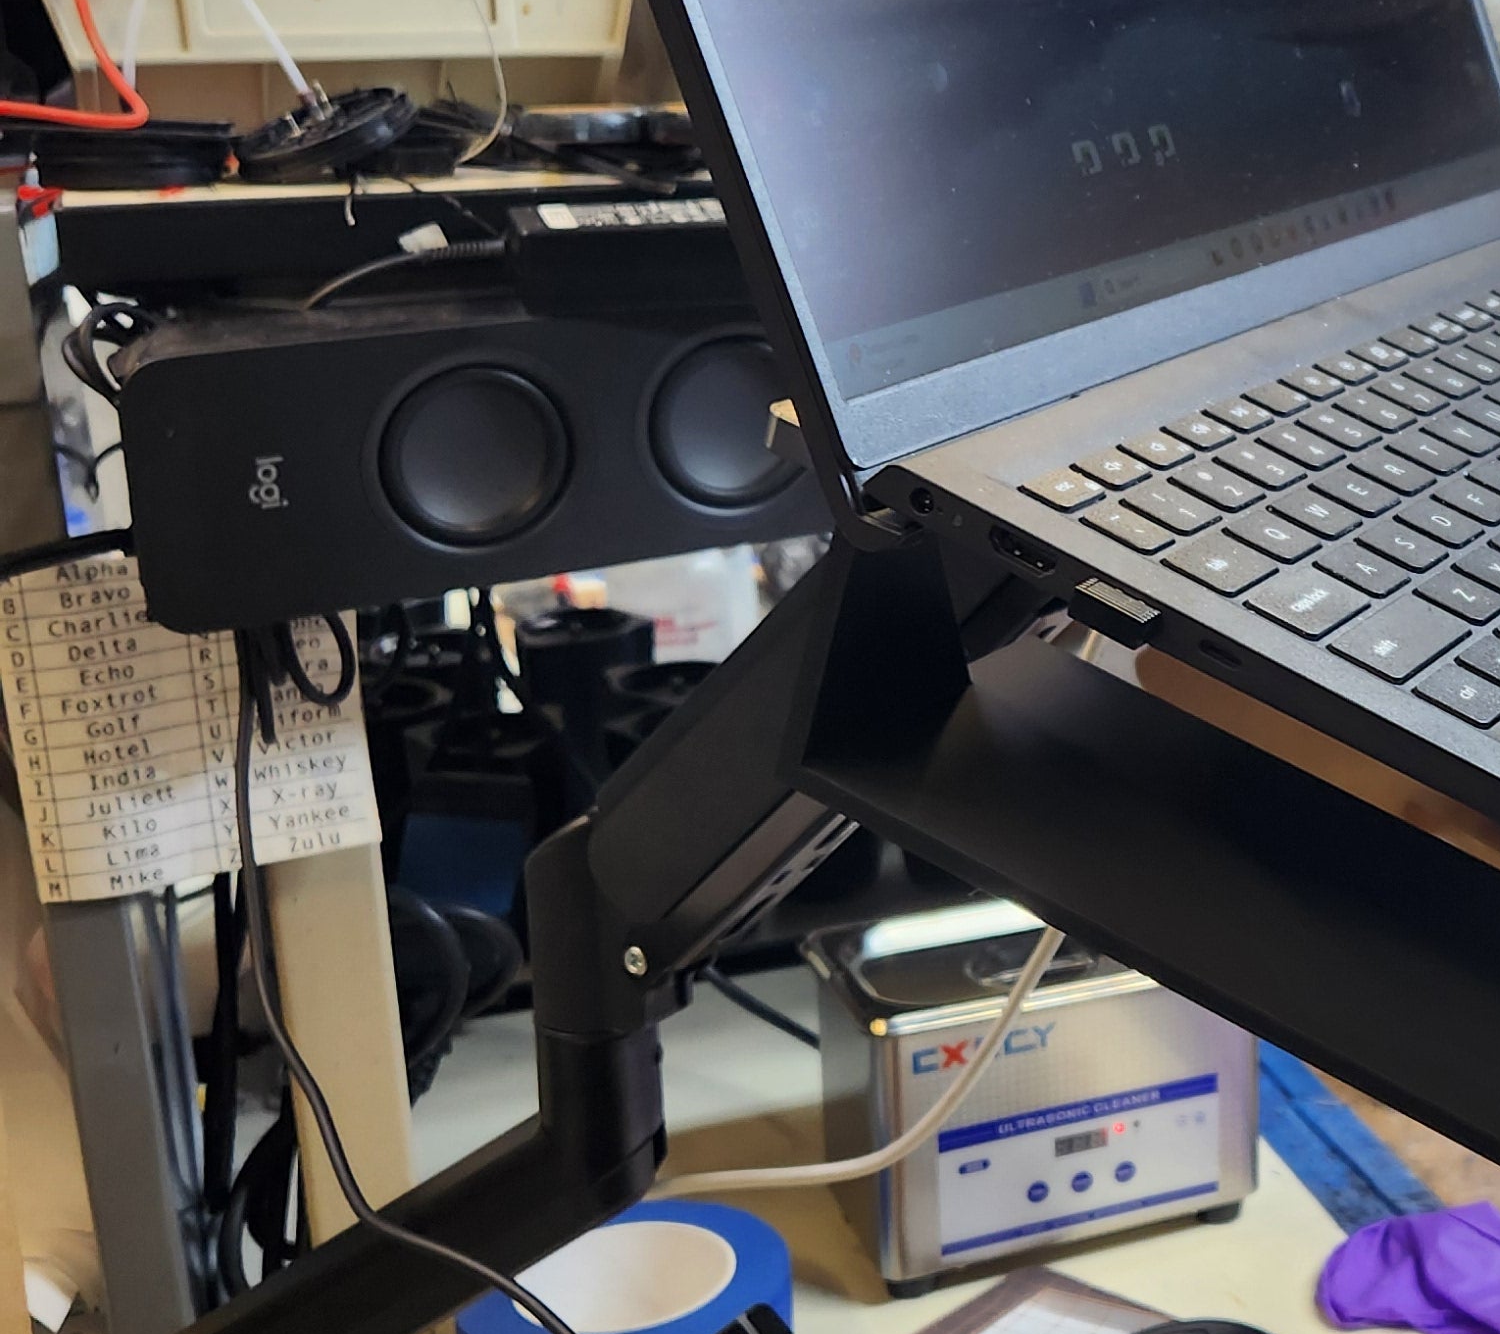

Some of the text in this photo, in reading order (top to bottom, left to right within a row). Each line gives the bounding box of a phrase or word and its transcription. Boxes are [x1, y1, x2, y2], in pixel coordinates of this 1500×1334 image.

[249, 456, 288, 509] logi
[1355, 562, 1379, 577] A
[1394, 537, 1416, 550] S
[56, 563, 129, 583] Alpha
[3, 587, 131, 615] B Bravo
[6, 624, 21, 642] C
[11, 638, 137, 668] D Delta
[200, 647, 213, 664] R
[16, 665, 135, 693] E Echo
[204, 674, 215, 691] S
[20, 684, 157, 720] F Foxtrot
[206, 698, 218, 715] T
[24, 714, 140, 746] G Golf
[210, 724, 222, 740] U
[28, 738, 150, 771] H Hotel
[212, 729, 336, 764] V Victor
[34, 766, 157, 797] I India
[214, 754, 347, 788] W Whiskey
[39, 784, 176, 823] J Juliett
[220, 782, 337, 815] X X-ray
[269, 804, 350, 830] Yankee
[40, 818, 157, 848] K Kilo
[288, 832, 341, 853] Zulu
[45, 844, 162, 874] L Lima
[48, 868, 164, 899] M Mike
[911, 1021, 1056, 1075] CXCY
[998, 1089, 1162, 1135] ULTRASONIC CLEANER
